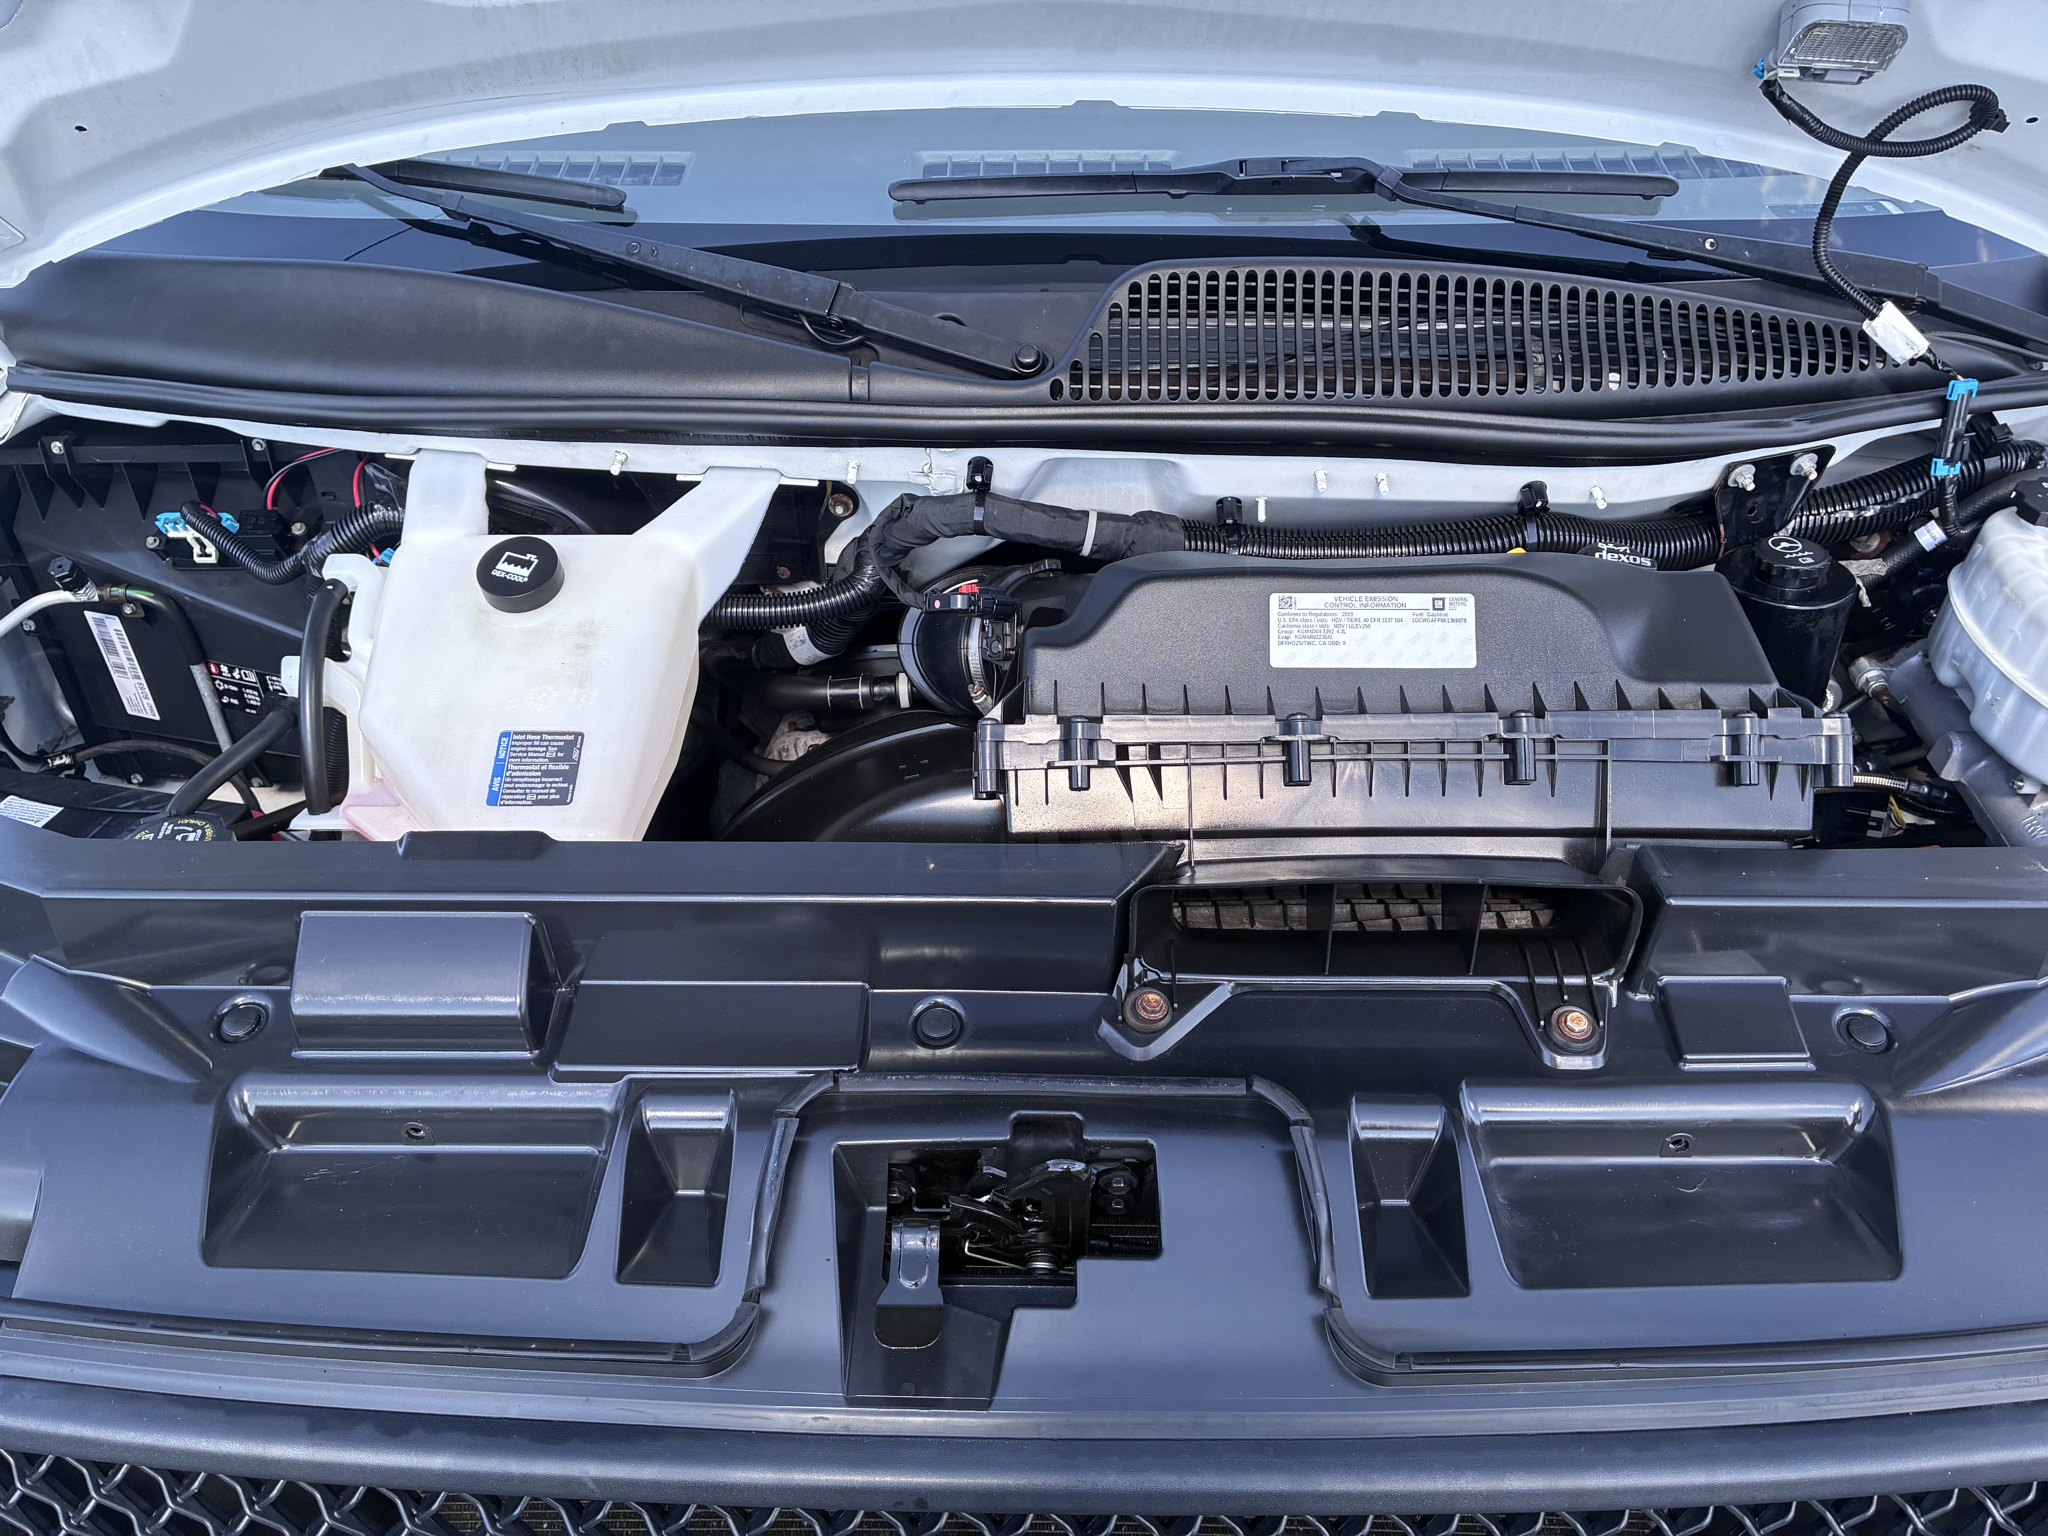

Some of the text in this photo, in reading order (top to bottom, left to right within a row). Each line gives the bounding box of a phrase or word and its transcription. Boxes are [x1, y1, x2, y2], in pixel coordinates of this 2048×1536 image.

[1595, 550, 1652, 566] dexos
[498, 737, 508, 758] NOTICE
[492, 777, 501, 791] AVIS
